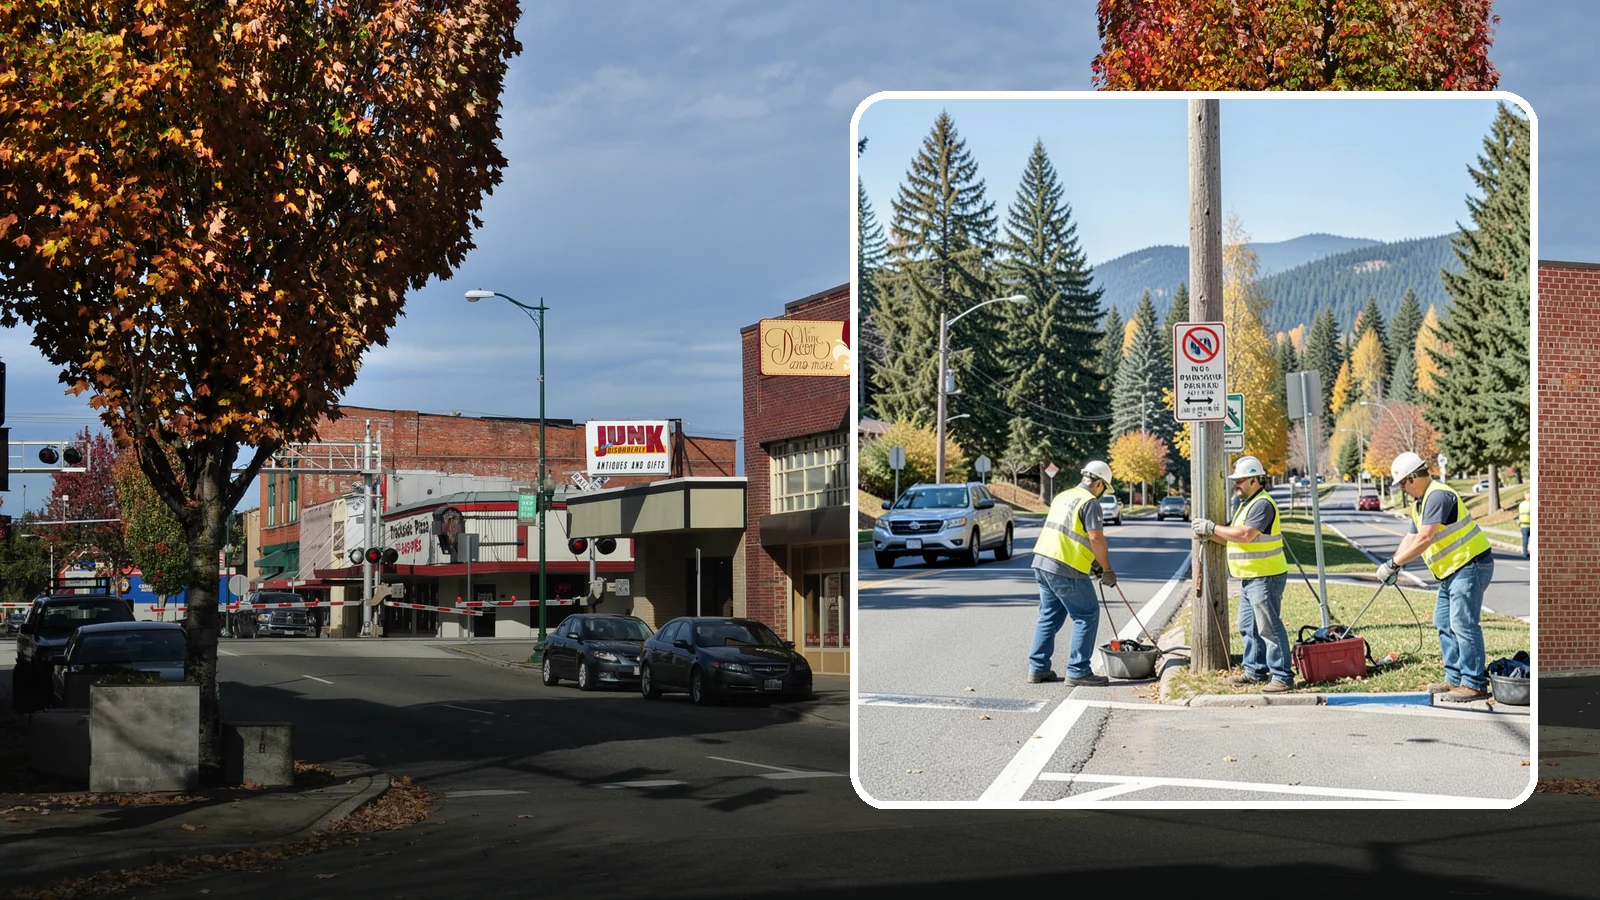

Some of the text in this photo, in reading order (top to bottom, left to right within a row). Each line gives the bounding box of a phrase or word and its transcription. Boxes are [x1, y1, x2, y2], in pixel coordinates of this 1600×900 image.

[595, 425, 665, 457] JUNK
[607, 446, 646, 454] DISORDERLY
[596, 460, 665, 470] ANTIQUES AND GIFTS
[573, 473, 588, 491] RAIL
[590, 476, 608, 492] SING
[352, 498, 364, 511] CRO
[390, 519, 429, 540] Trackside Pizza
